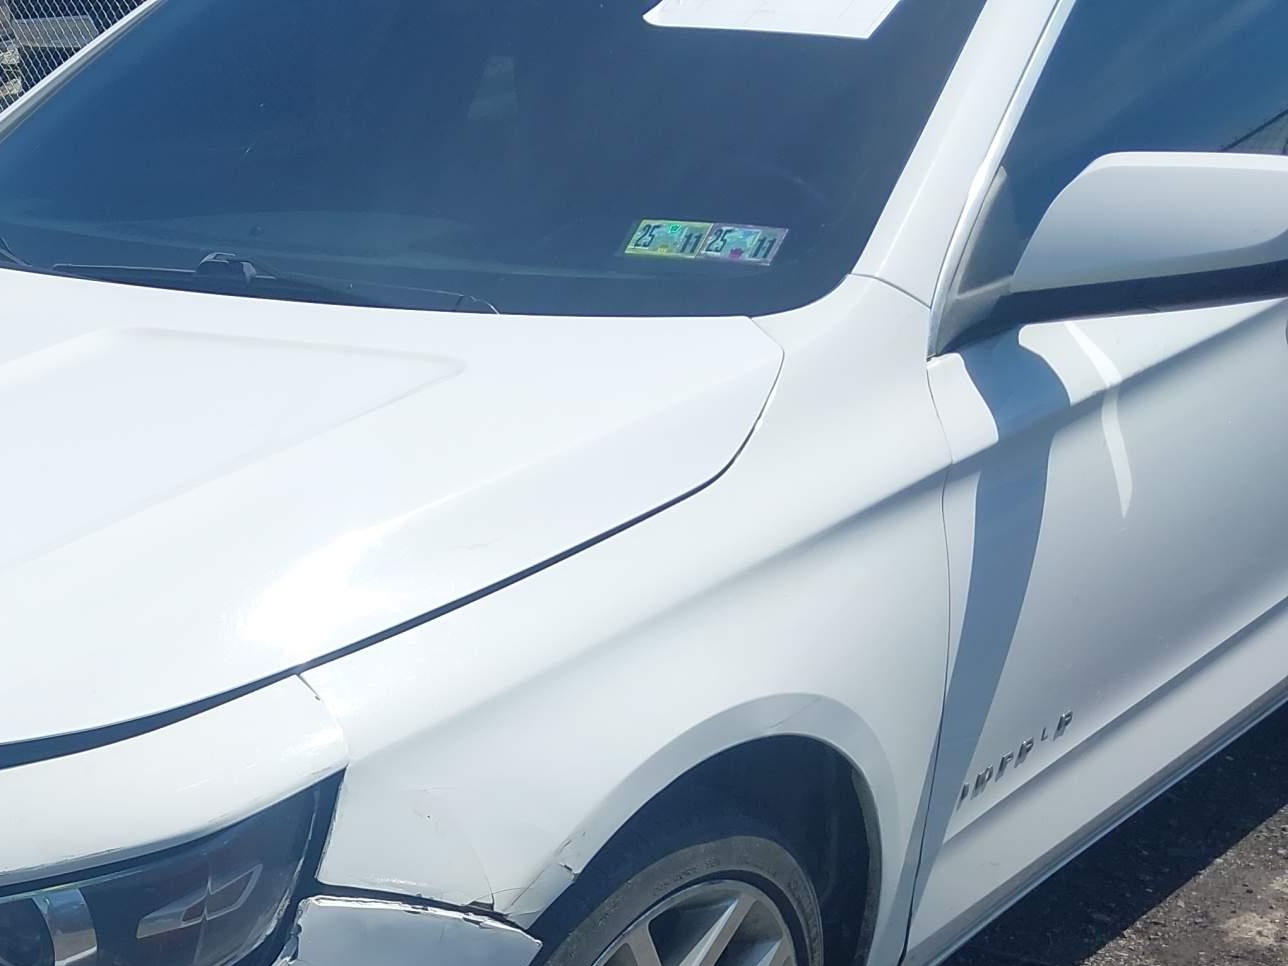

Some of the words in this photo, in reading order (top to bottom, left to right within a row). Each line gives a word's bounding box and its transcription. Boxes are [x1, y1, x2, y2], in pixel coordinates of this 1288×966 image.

[635, 224, 661, 248] 25
[680, 232, 703, 254] 11
[705, 229, 732, 253] 25
[751, 237, 776, 259] 11
